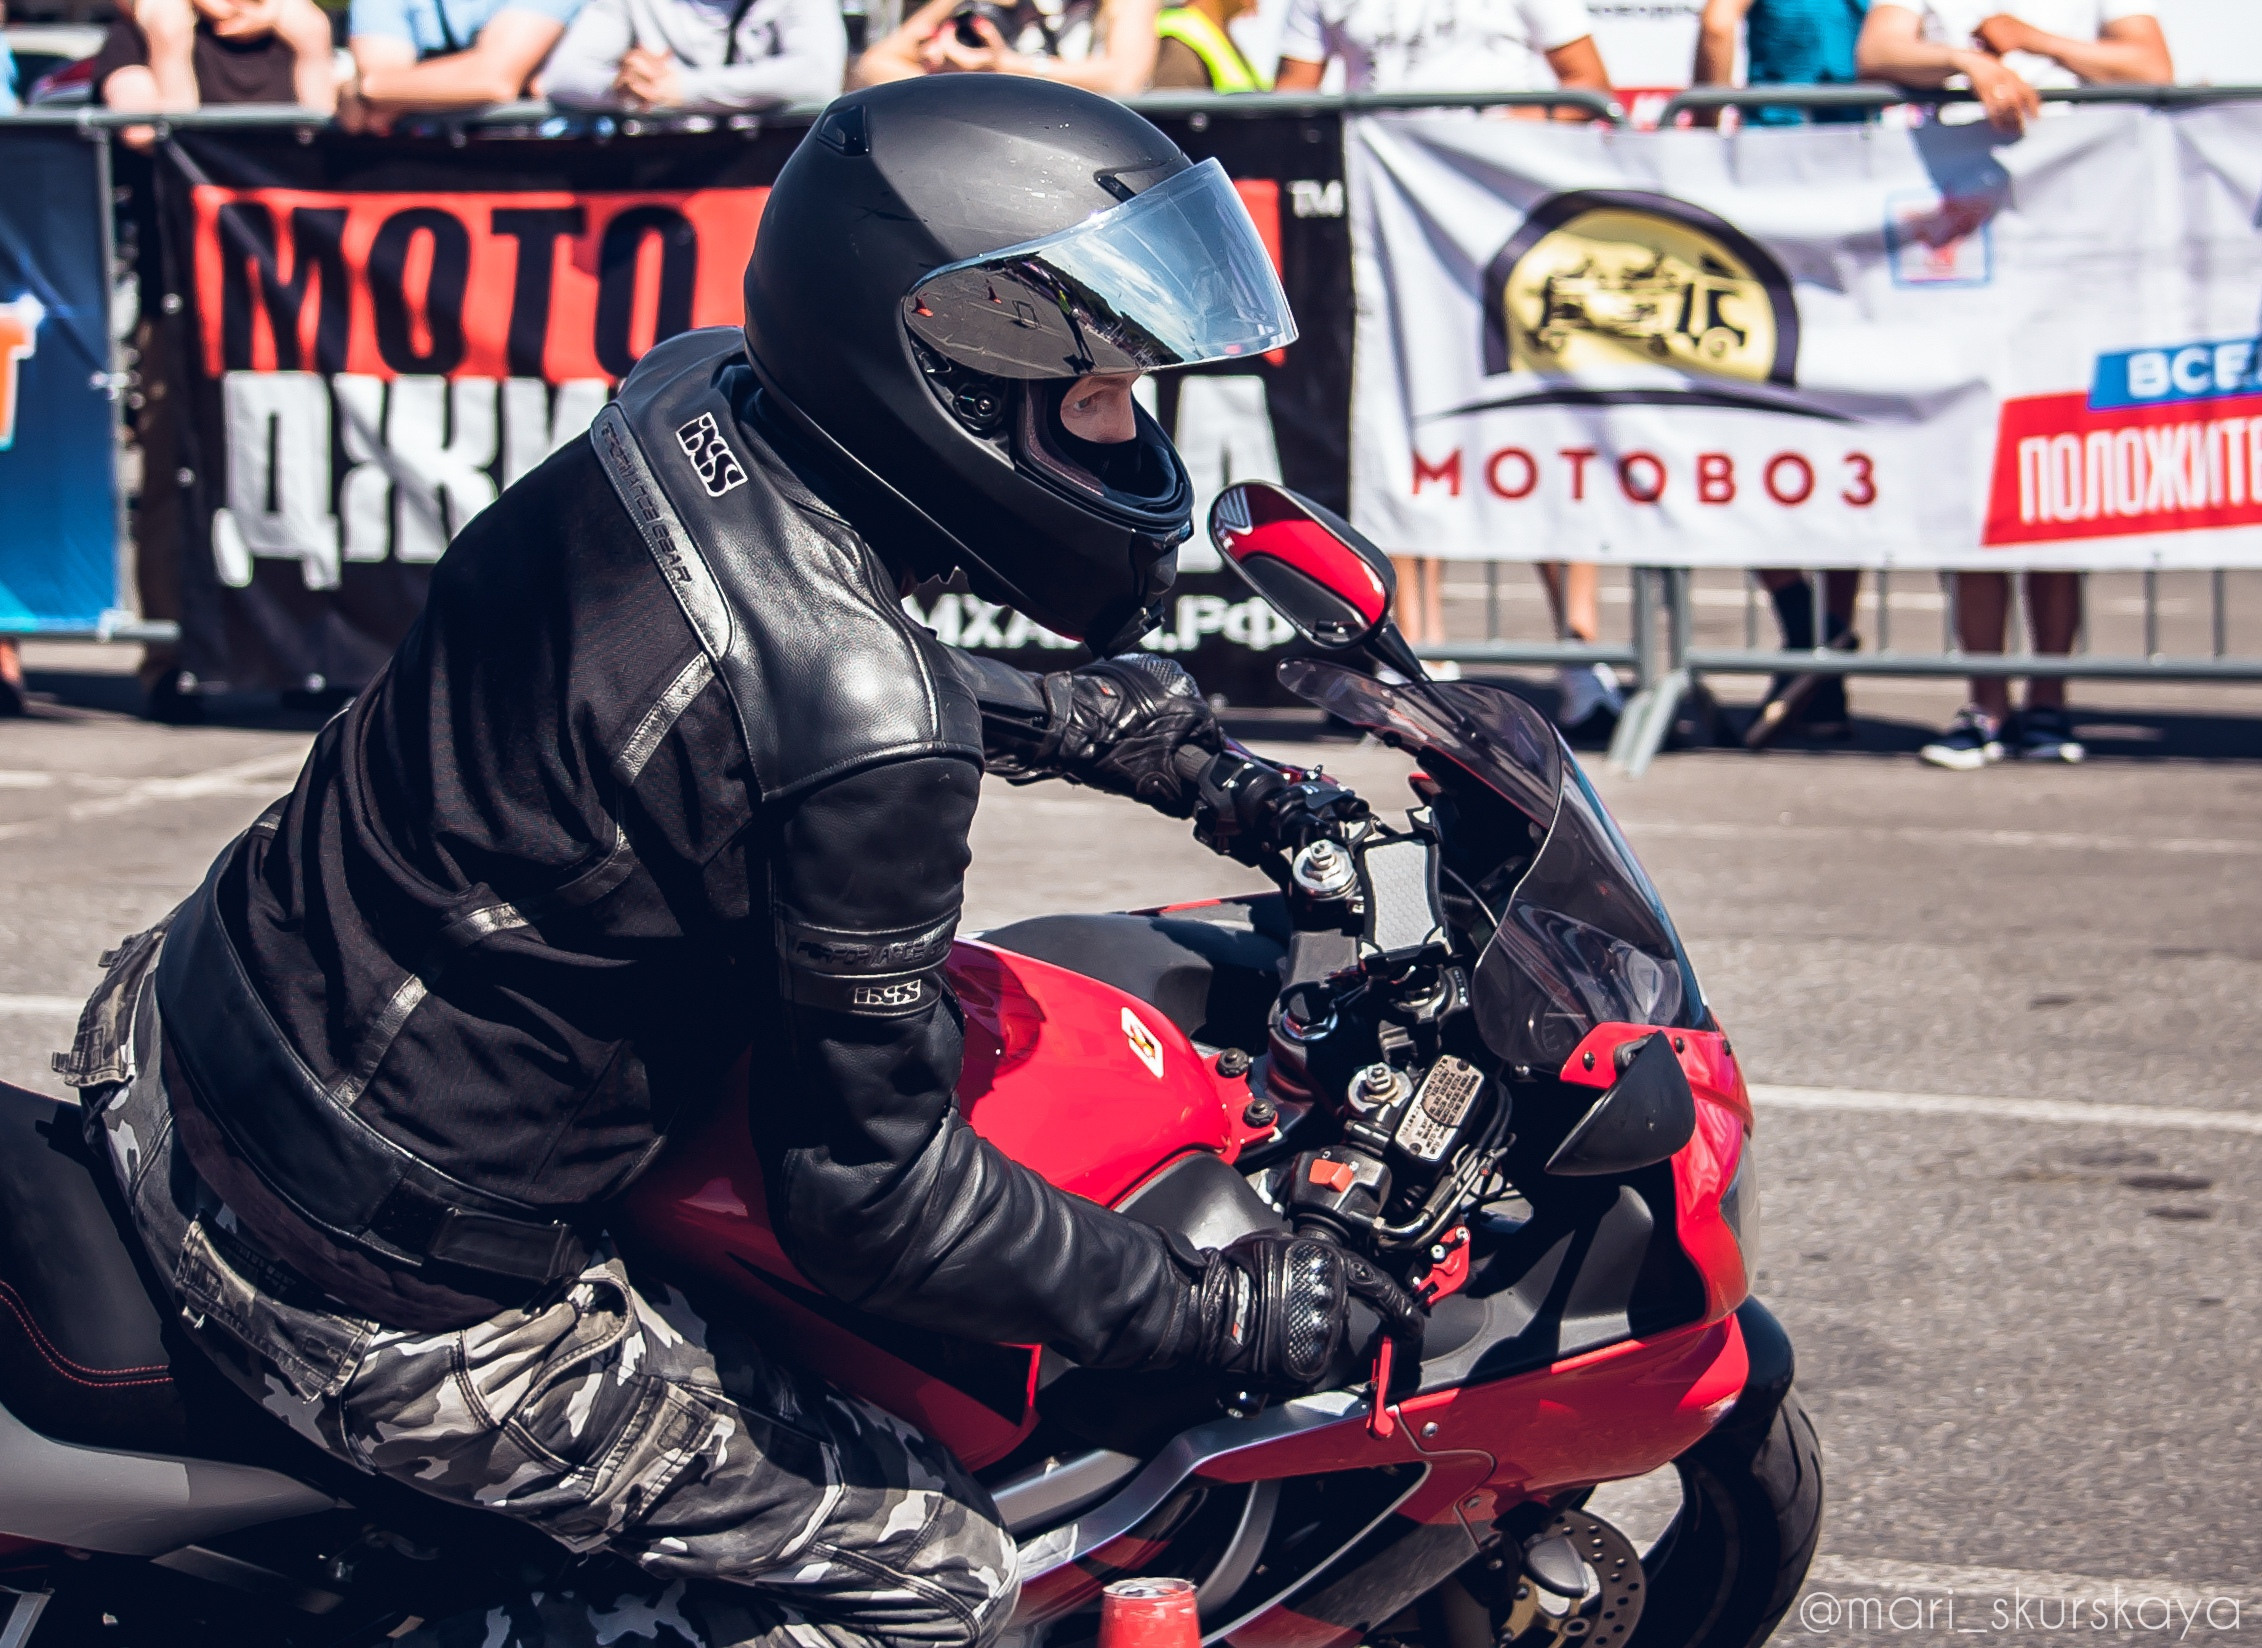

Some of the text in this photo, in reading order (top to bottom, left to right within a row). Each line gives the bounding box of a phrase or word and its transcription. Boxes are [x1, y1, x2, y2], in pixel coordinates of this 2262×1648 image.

[1287, 180, 1344, 217] TM
[218, 204, 698, 376] МОТО
[2127, 342, 2262, 399] ВСЕ
[1411, 447, 1879, 507] МОТОВОЗ
[652, 523, 693, 585] GEAR
